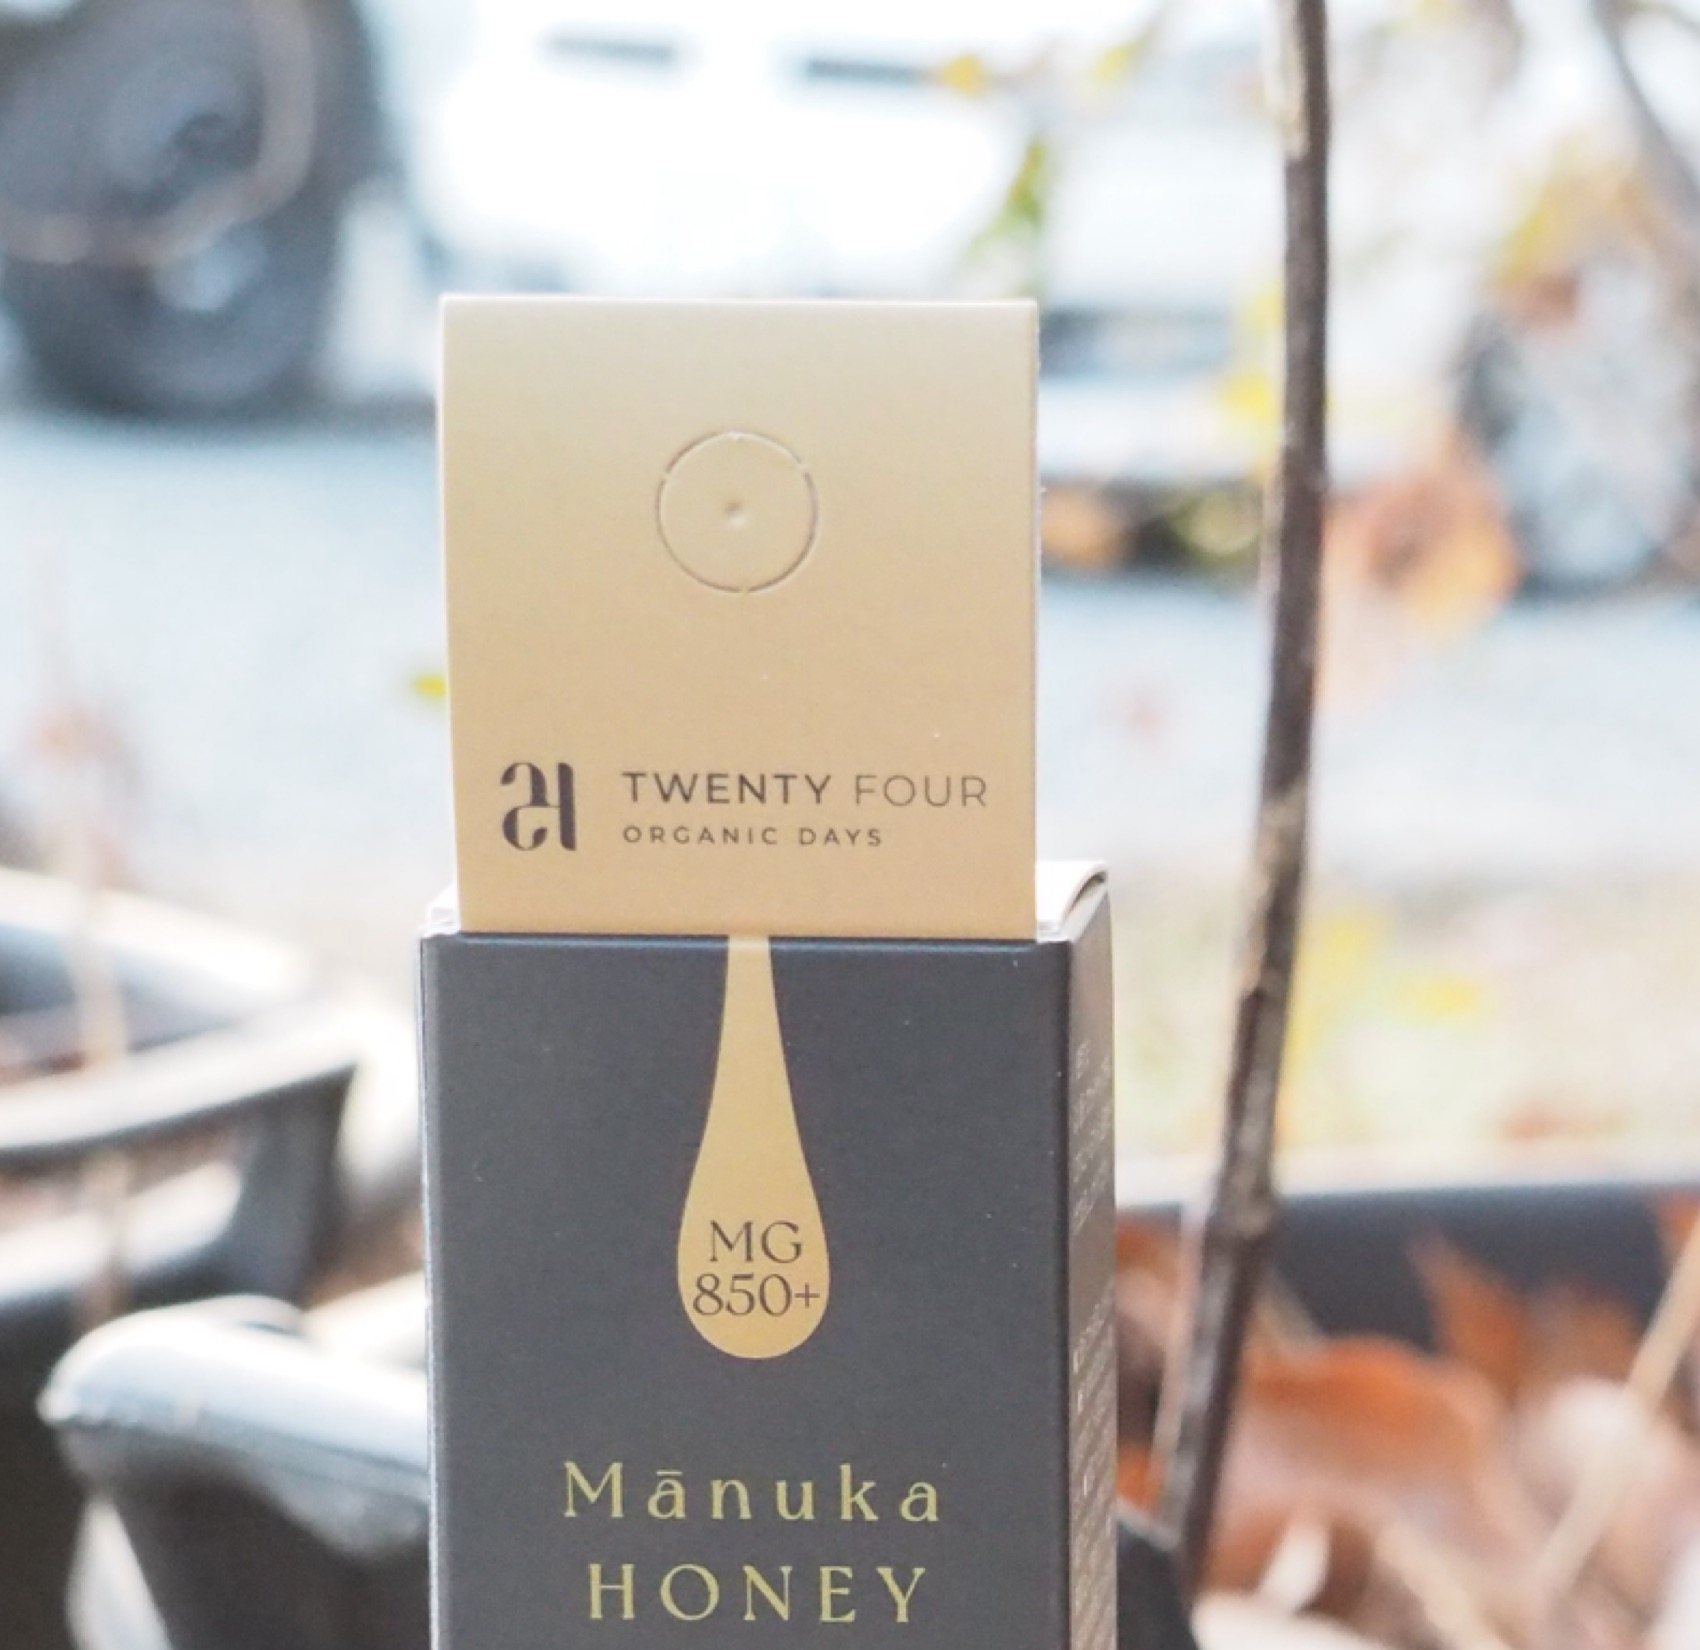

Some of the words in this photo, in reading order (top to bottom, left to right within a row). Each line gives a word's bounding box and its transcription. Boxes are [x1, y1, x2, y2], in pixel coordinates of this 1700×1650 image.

[622, 771, 832, 805] TWENTY
[854, 774, 988, 808] FOUR
[622, 825, 779, 846] ORGANIC
[798, 826, 883, 848] DAYS
[708, 1219, 804, 1265] MG
[692, 1273, 821, 1317] 850+
[563, 1461, 939, 1522] Mānuka
[589, 1562, 926, 1623] HONEY
